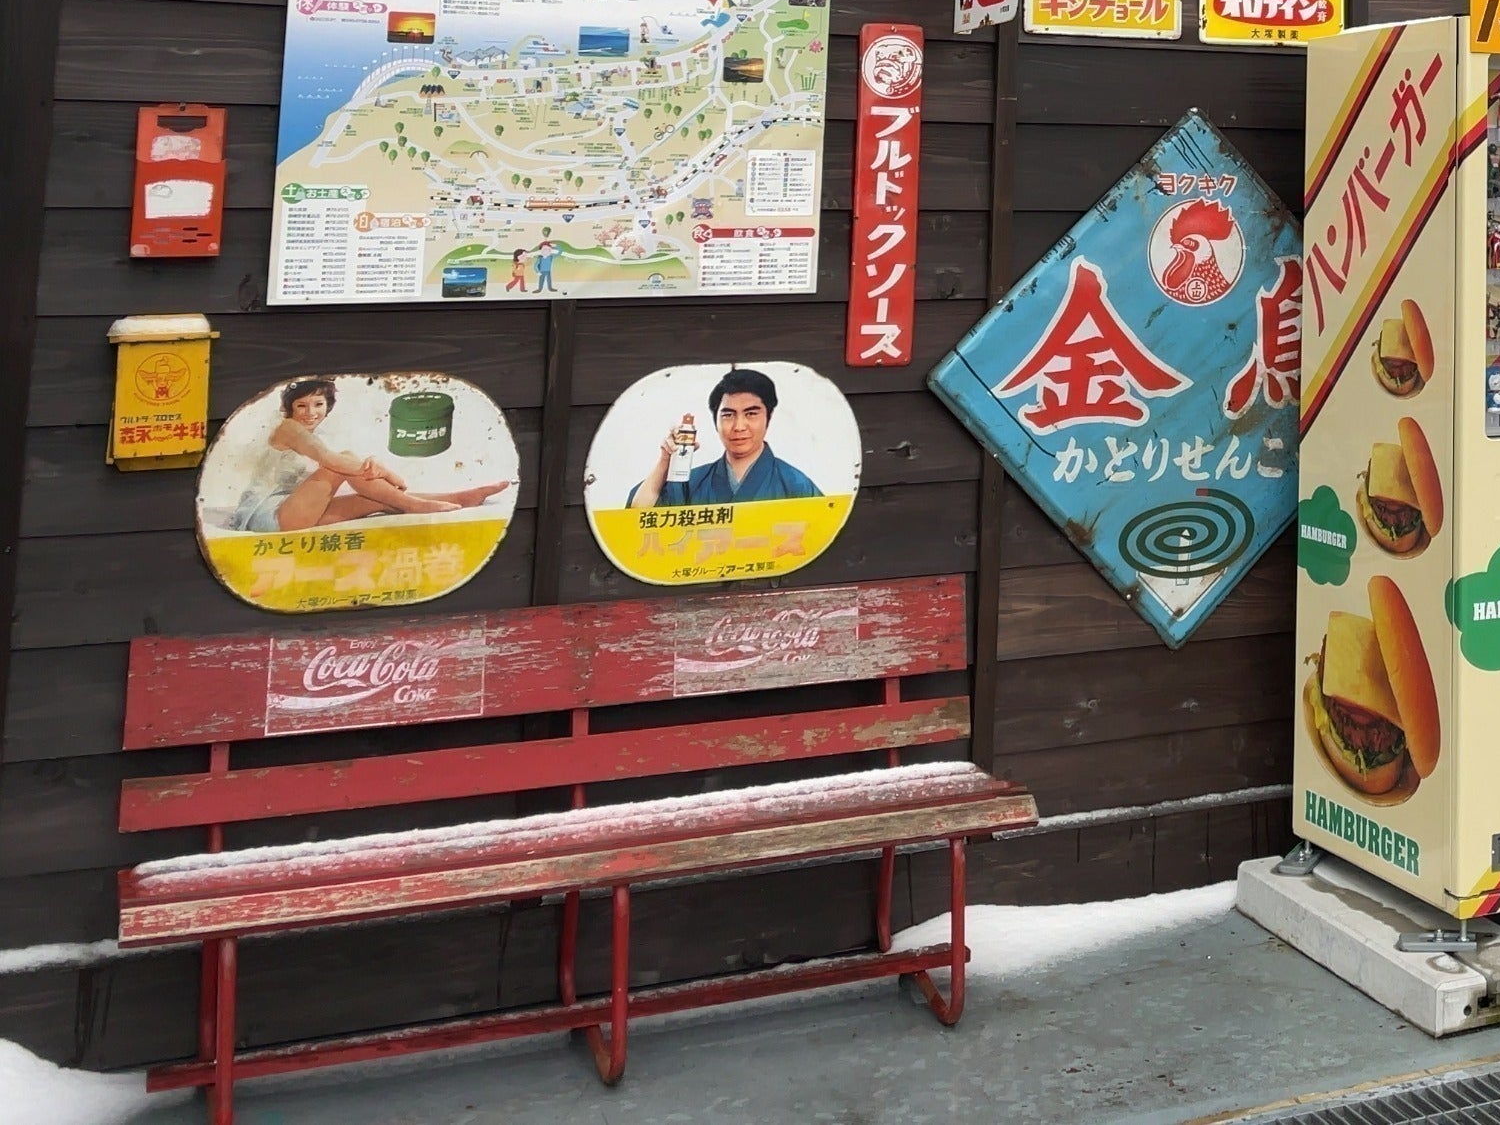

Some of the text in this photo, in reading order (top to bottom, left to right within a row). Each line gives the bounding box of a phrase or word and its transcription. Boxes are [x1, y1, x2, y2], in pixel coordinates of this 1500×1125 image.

[1251, 29, 1299, 39] 大塚製薬
[1158, 172, 1238, 196] ヨクキク
[1305, 53, 1443, 337] ハンバーガー
[861, 105, 920, 360] ブルドックソース
[639, 506, 734, 529] 強力殺虫剤
[253, 532, 366, 556] かとり線香
[1300, 523, 1347, 550] HAMBURGER
[350, 640, 377, 649] Enjoy
[393, 685, 437, 704] Coke
[1304, 788, 1420, 877] HAMBURGER
